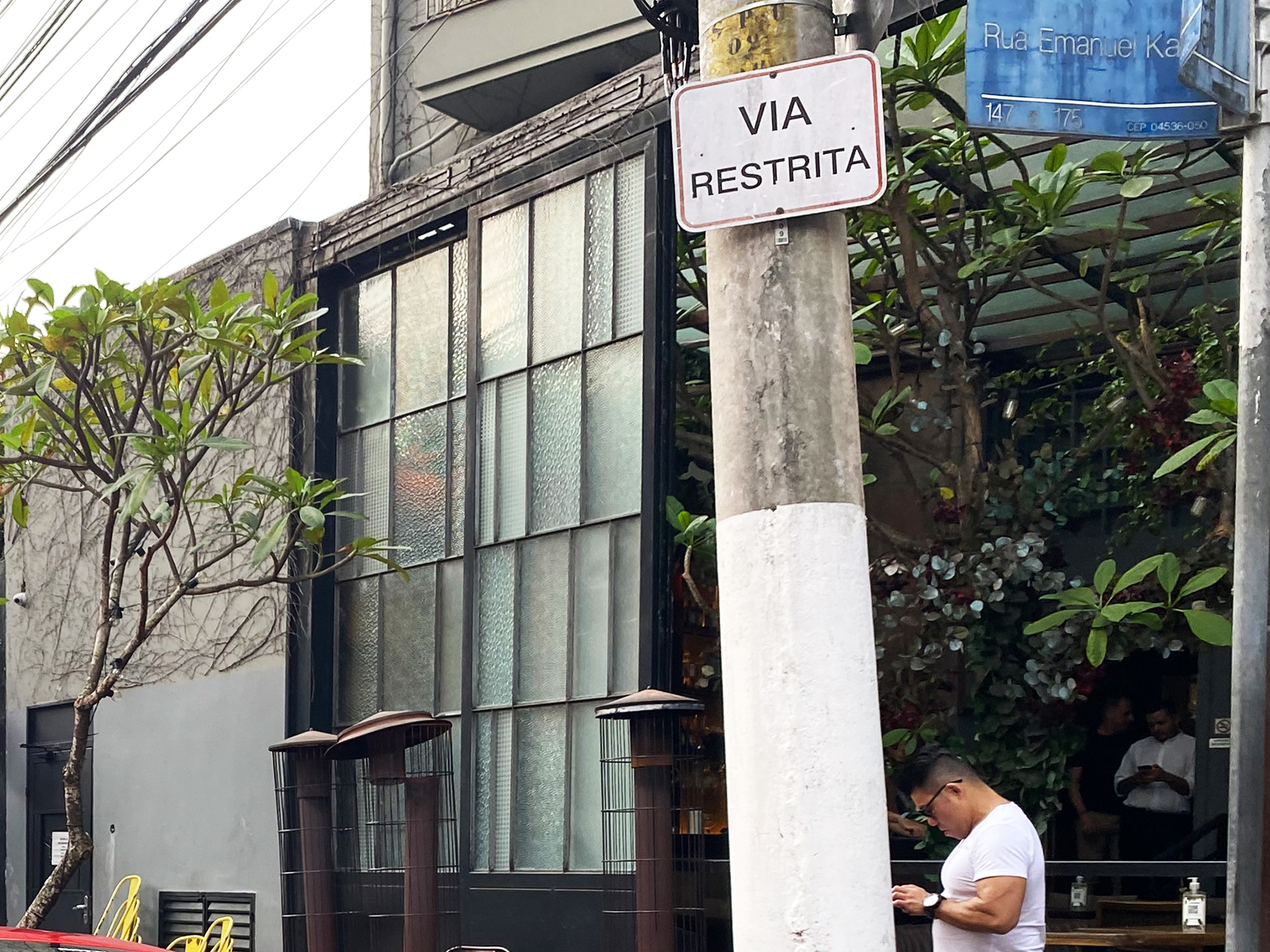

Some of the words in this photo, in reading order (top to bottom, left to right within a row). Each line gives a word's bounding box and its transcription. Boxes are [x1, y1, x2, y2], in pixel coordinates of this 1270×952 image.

[984, 22, 1027, 51] Rua
[738, 96, 812, 135] VIA
[985, 101, 1013, 123] 147
[1055, 107, 1083, 128] 175
[1126, 122, 1147, 133] CEP
[691, 145, 871, 198] RESTRITA
